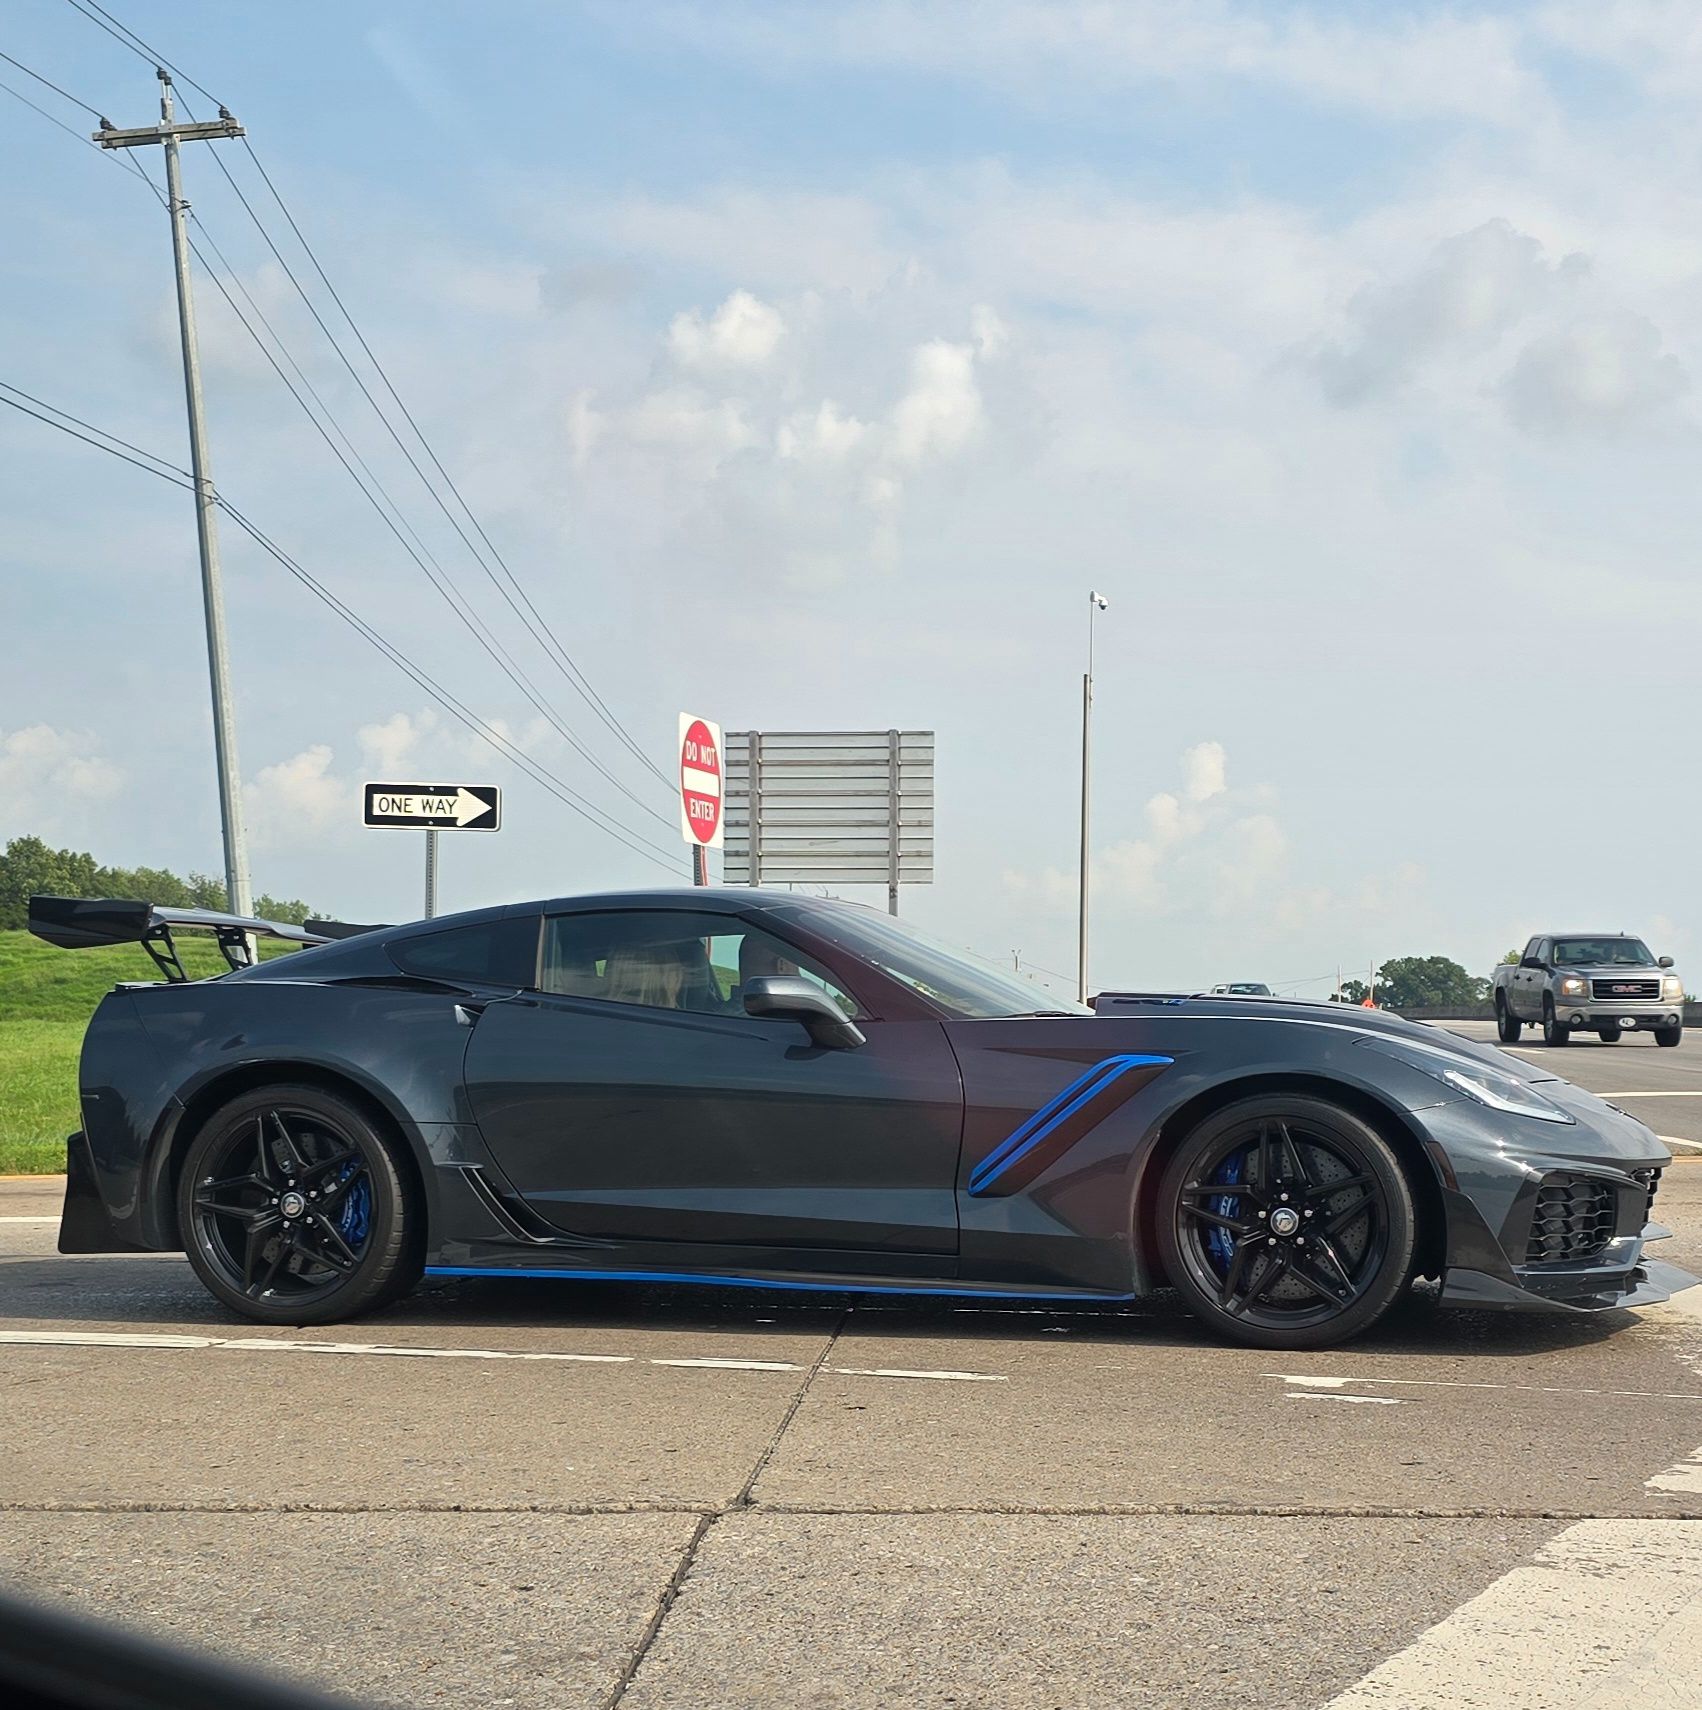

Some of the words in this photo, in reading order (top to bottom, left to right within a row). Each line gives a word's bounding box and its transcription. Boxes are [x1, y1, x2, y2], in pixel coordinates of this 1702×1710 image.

[685, 740, 698, 762] DO
[700, 747, 716, 767] NOT
[378, 796, 414, 814] ONE
[421, 798, 458, 815] WAY
[690, 797, 715, 822] ENTER
[1611, 984, 1643, 993] GMC
